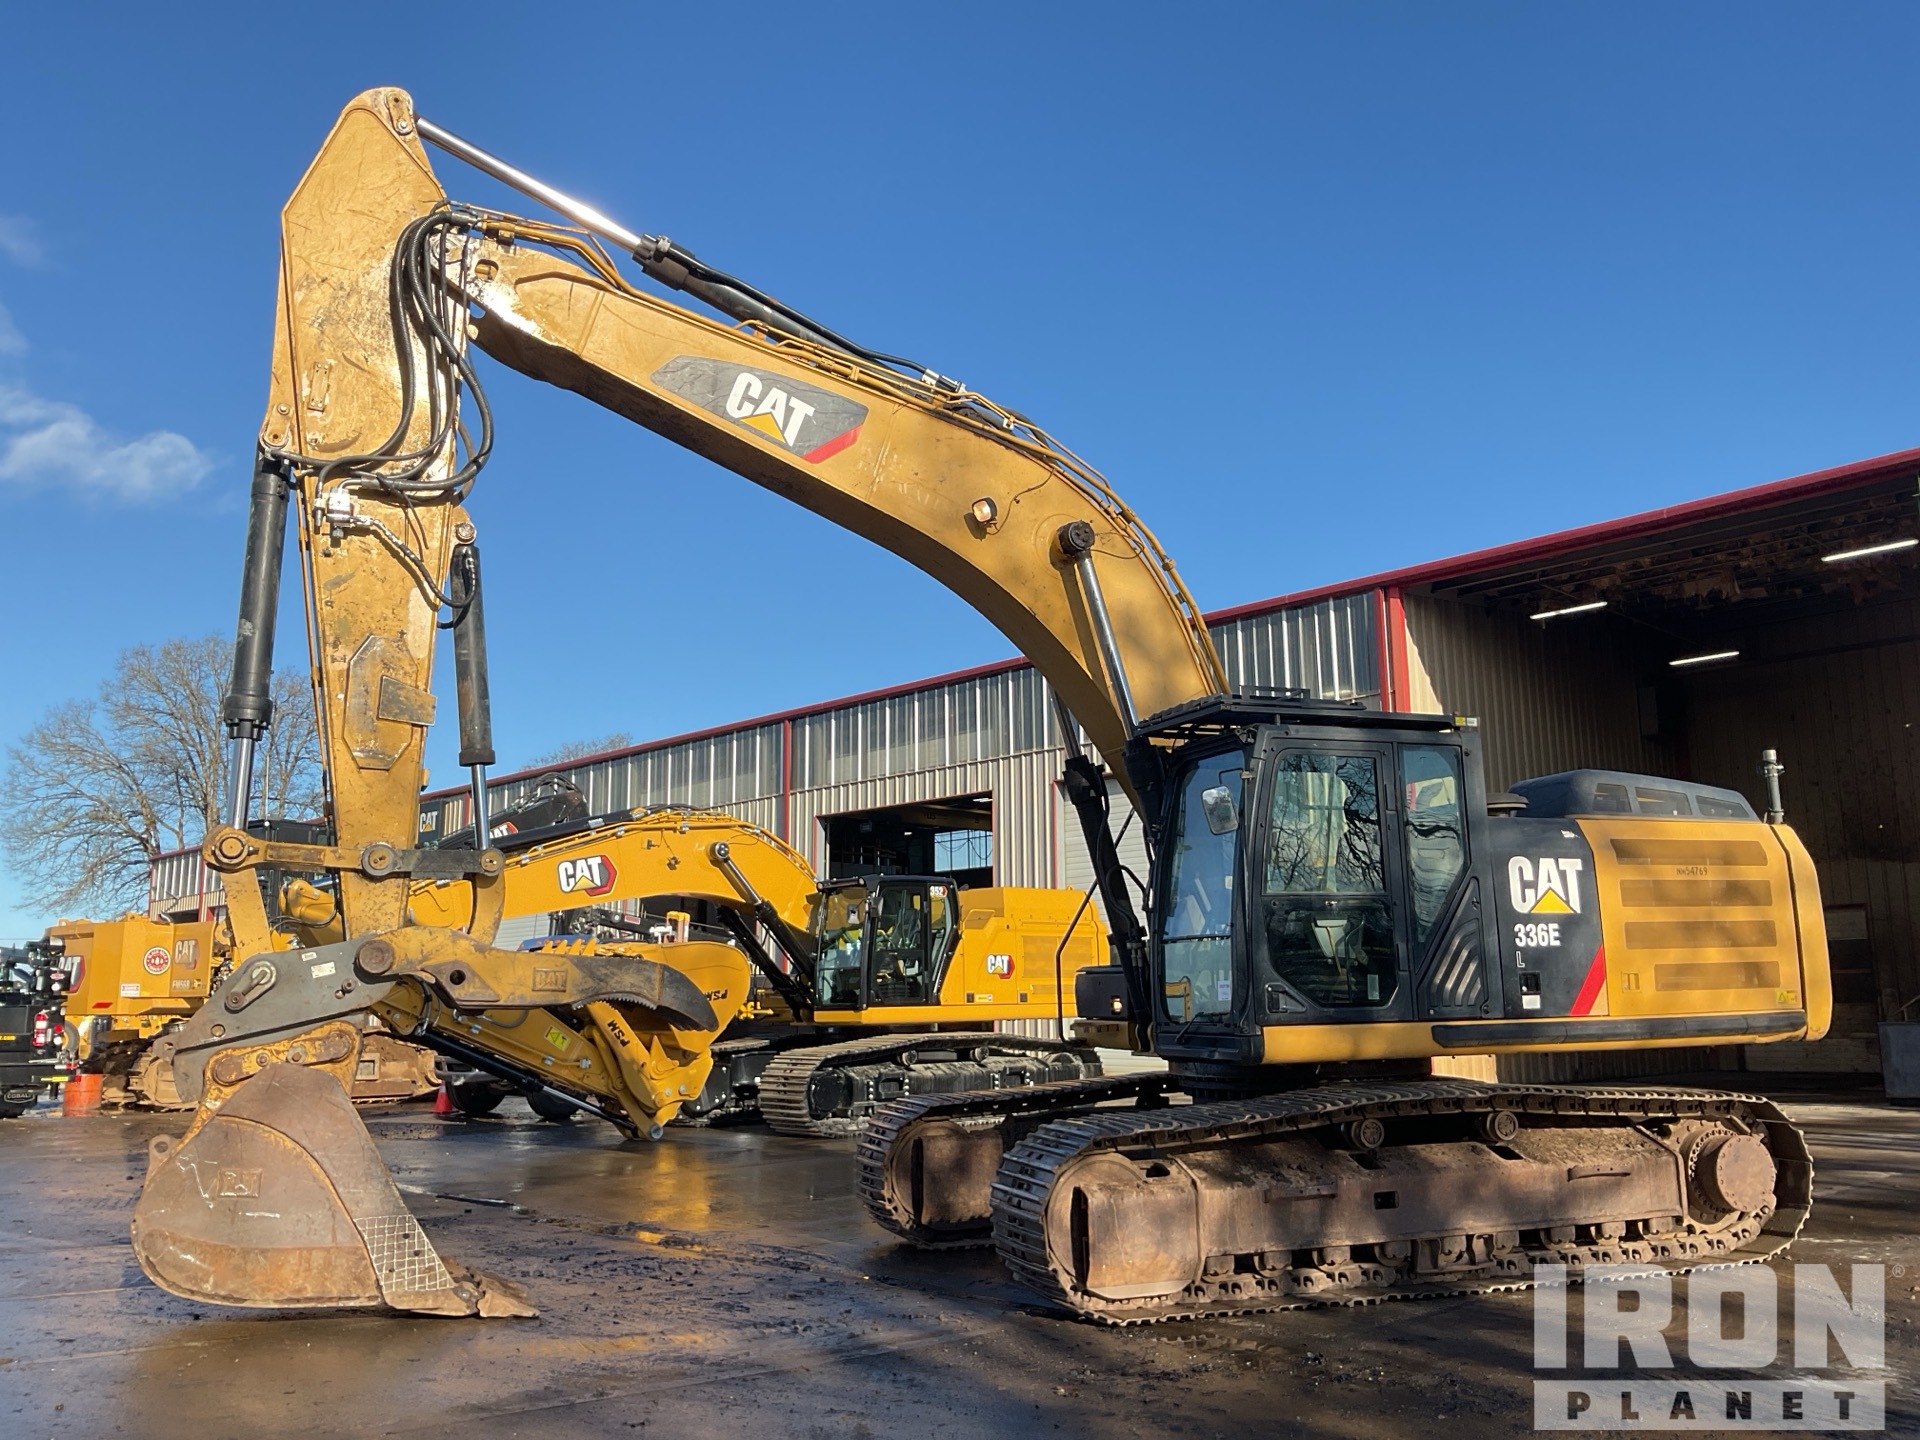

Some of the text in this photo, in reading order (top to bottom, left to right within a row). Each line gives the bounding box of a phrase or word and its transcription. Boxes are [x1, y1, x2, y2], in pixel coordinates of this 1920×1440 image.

[725, 372, 816, 447] CAT
[420, 811, 438, 832] CAT
[558, 856, 602, 892] CAT
[1508, 856, 1583, 914] CAT
[930, 886, 943, 896] 352
[1514, 923, 1562, 947] 336E
[175, 940, 196, 963] CAT
[1516, 951, 1525, 968] L
[987, 955, 1009, 974] CAT
[534, 970, 567, 989] CAT
[607, 1020, 631, 1047] PSM
